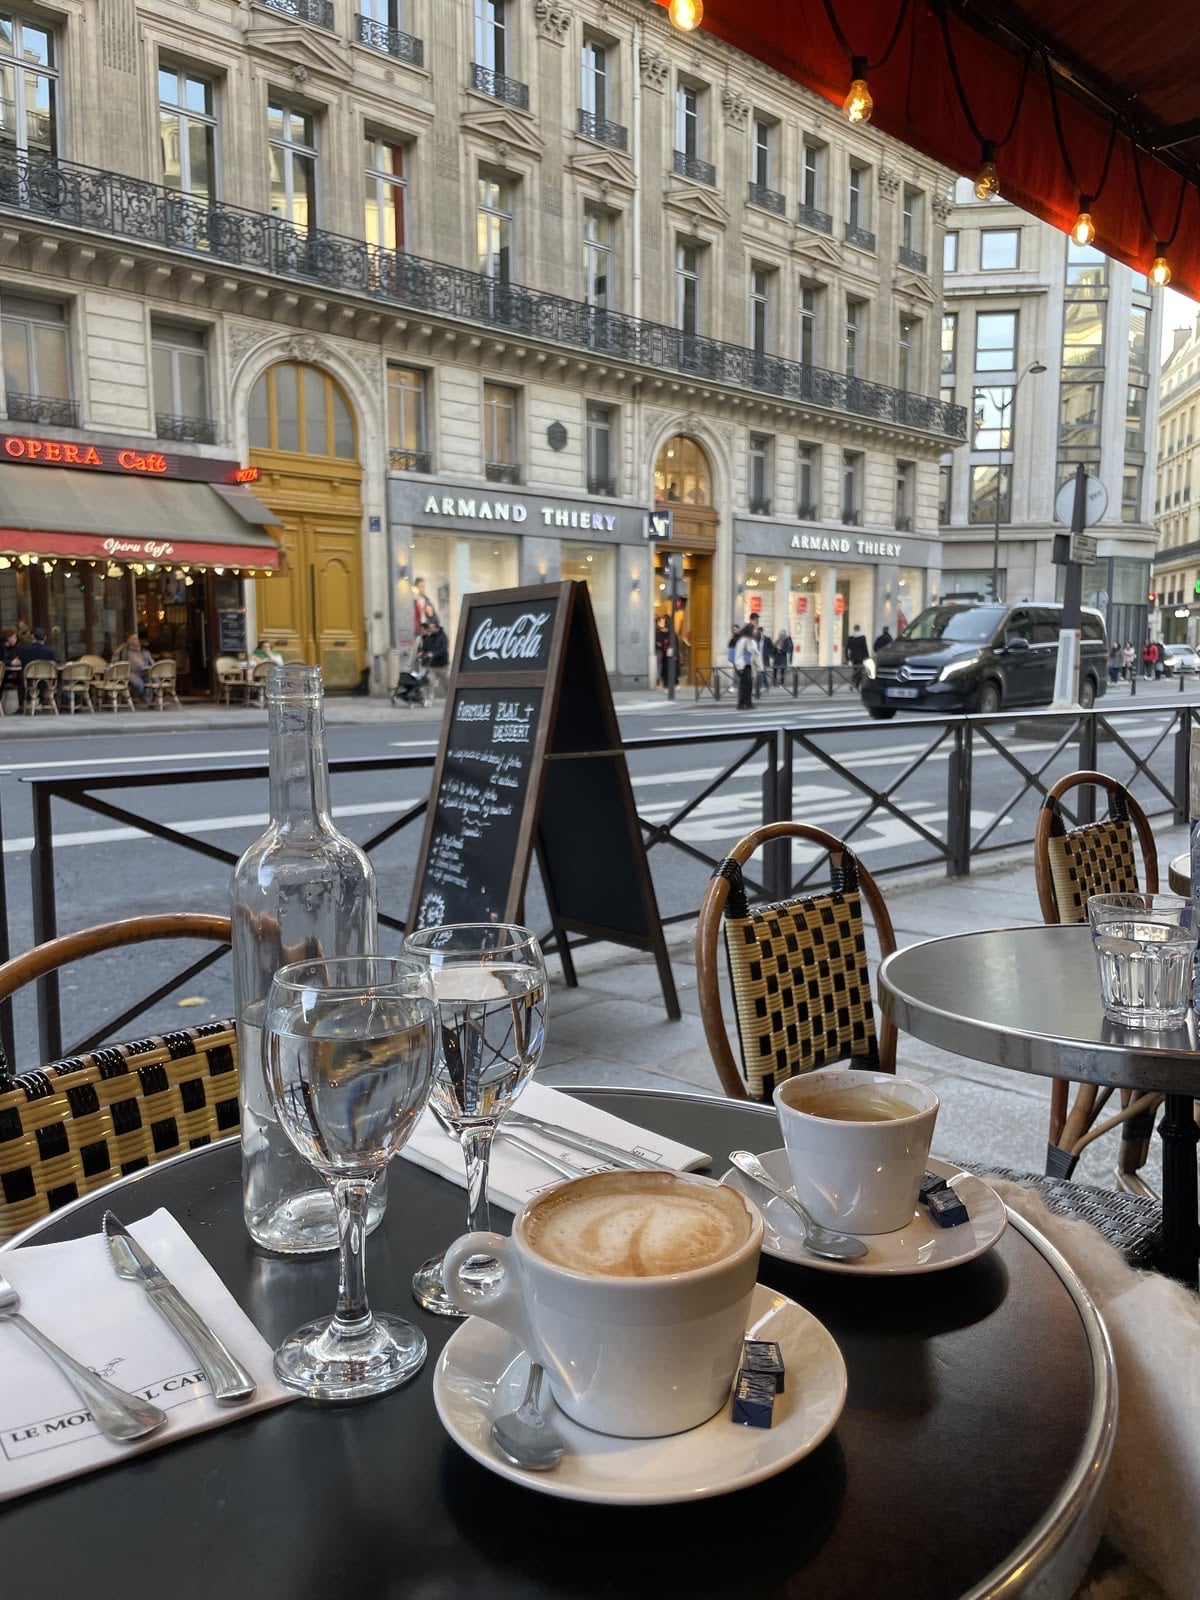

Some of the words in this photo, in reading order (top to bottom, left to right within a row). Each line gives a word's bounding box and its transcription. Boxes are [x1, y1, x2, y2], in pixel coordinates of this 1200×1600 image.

[5, 437, 103, 465] OPERA
[118, 450, 168, 473] Café
[424, 495, 528, 522] ARMAND
[541, 506, 616, 531] THIERY
[791, 534, 851, 553] ARMAND
[857, 540, 902, 557] THIERY
[493, 724, 531, 739] DESSERT
[11, 1426, 40, 1443] LE
[163, 1372, 208, 1392] CAF
